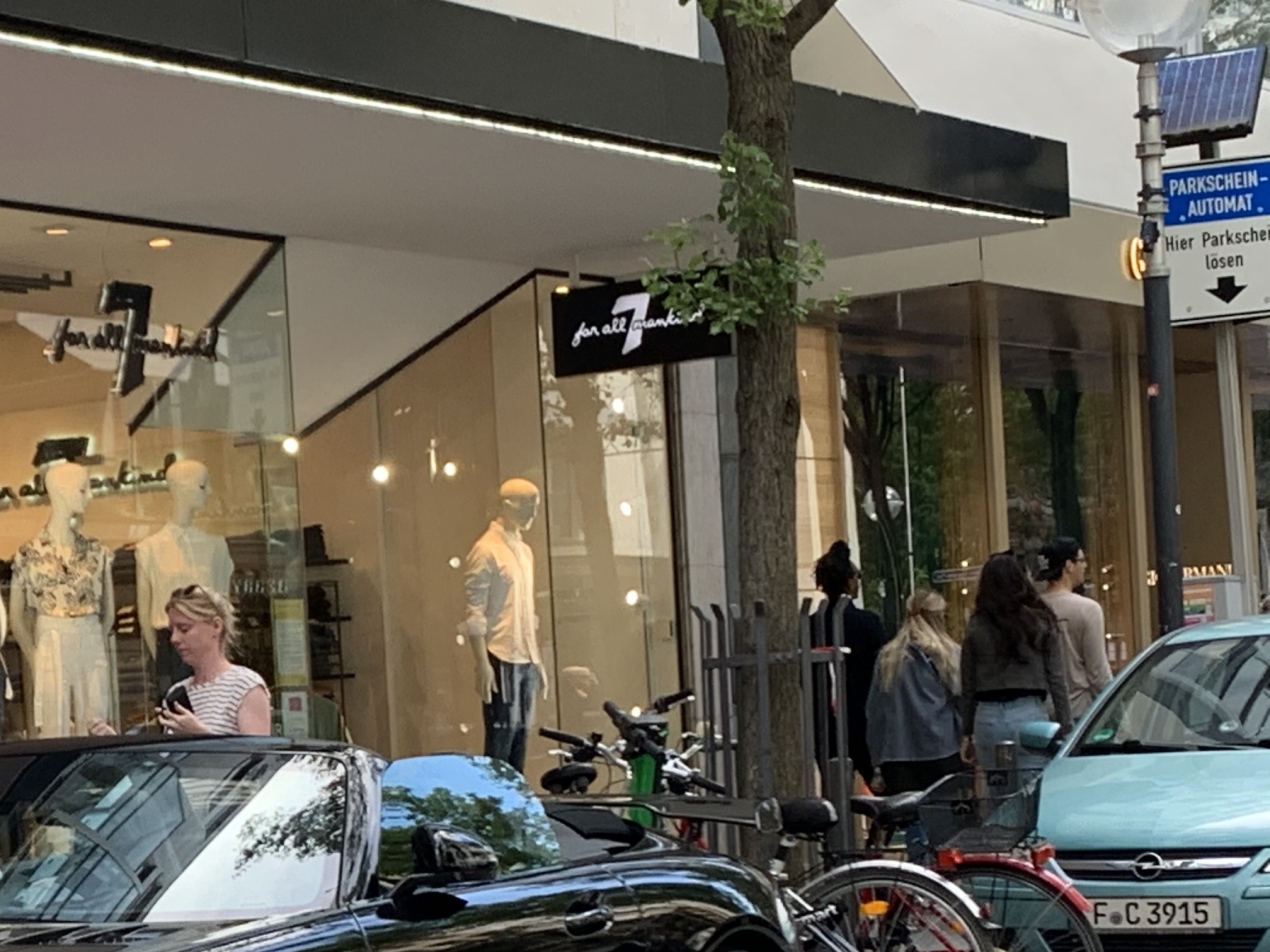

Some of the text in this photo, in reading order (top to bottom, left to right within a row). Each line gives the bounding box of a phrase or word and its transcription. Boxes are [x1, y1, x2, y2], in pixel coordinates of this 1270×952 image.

[1169, 169, 1269, 197] PARKSCHEIN-
[1188, 193, 1254, 217] AUTOMAT
[1165, 235, 1195, 252] Hier
[1205, 252, 1244, 270] lösen
[571, 321, 600, 347] for
[601, 317, 626, 333] all
[611, 292, 651, 355] 7
[99, 280, 154, 397] 7
[19, 473, 50, 497] al
[89, 452, 178, 492] ankind
[1182, 563, 1233, 578] RMANI
[1094, 902, 1209, 925] F C 3915
